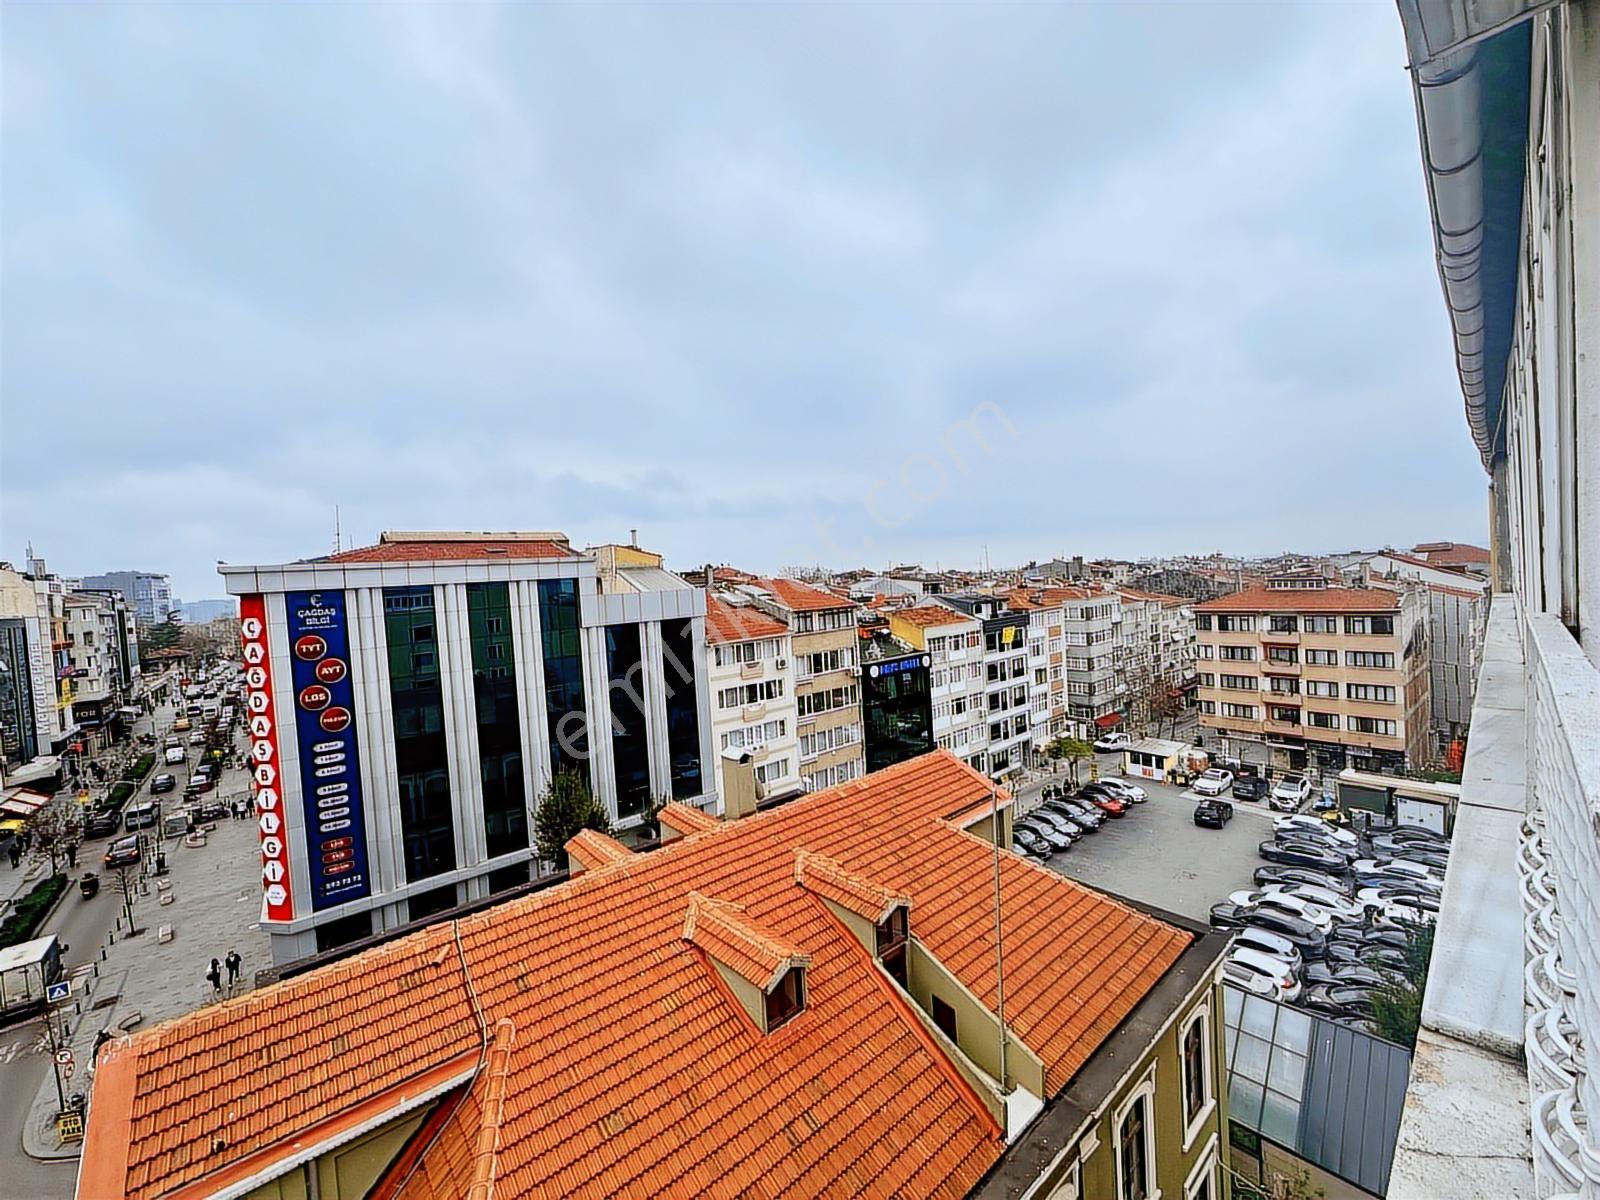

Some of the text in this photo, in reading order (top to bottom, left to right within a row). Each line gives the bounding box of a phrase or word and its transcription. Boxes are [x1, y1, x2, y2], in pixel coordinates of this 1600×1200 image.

[300, 643, 323, 653] TYT
[321, 665, 342, 675] AYT
[247, 621, 266, 759] ÇAĞDAŞ
[33, 675, 50, 735] Mercure
[62, 1118, 79, 1128] OTO
[61, 1126, 81, 1136] PARK
